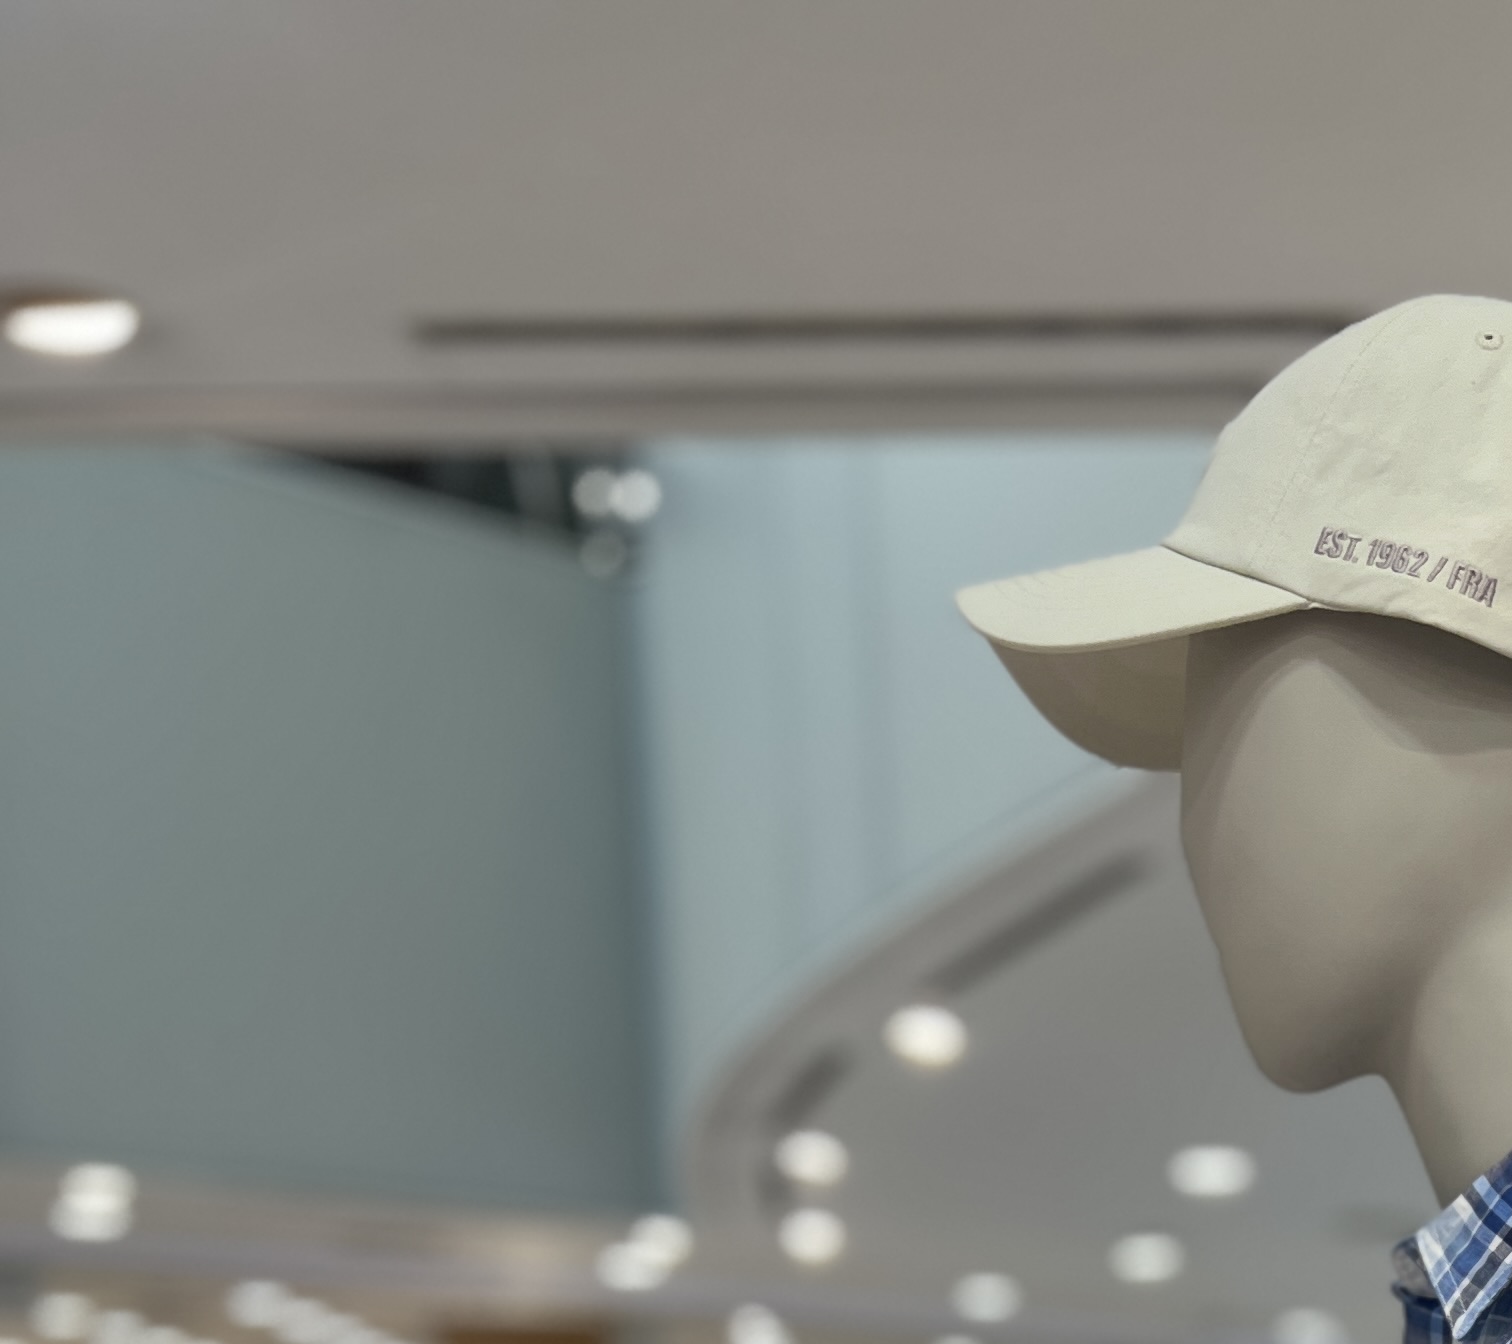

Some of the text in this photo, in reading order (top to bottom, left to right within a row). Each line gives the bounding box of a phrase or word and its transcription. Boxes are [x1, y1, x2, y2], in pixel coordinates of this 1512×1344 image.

[1314, 526, 1498, 607] EST. 1962 / FRA
